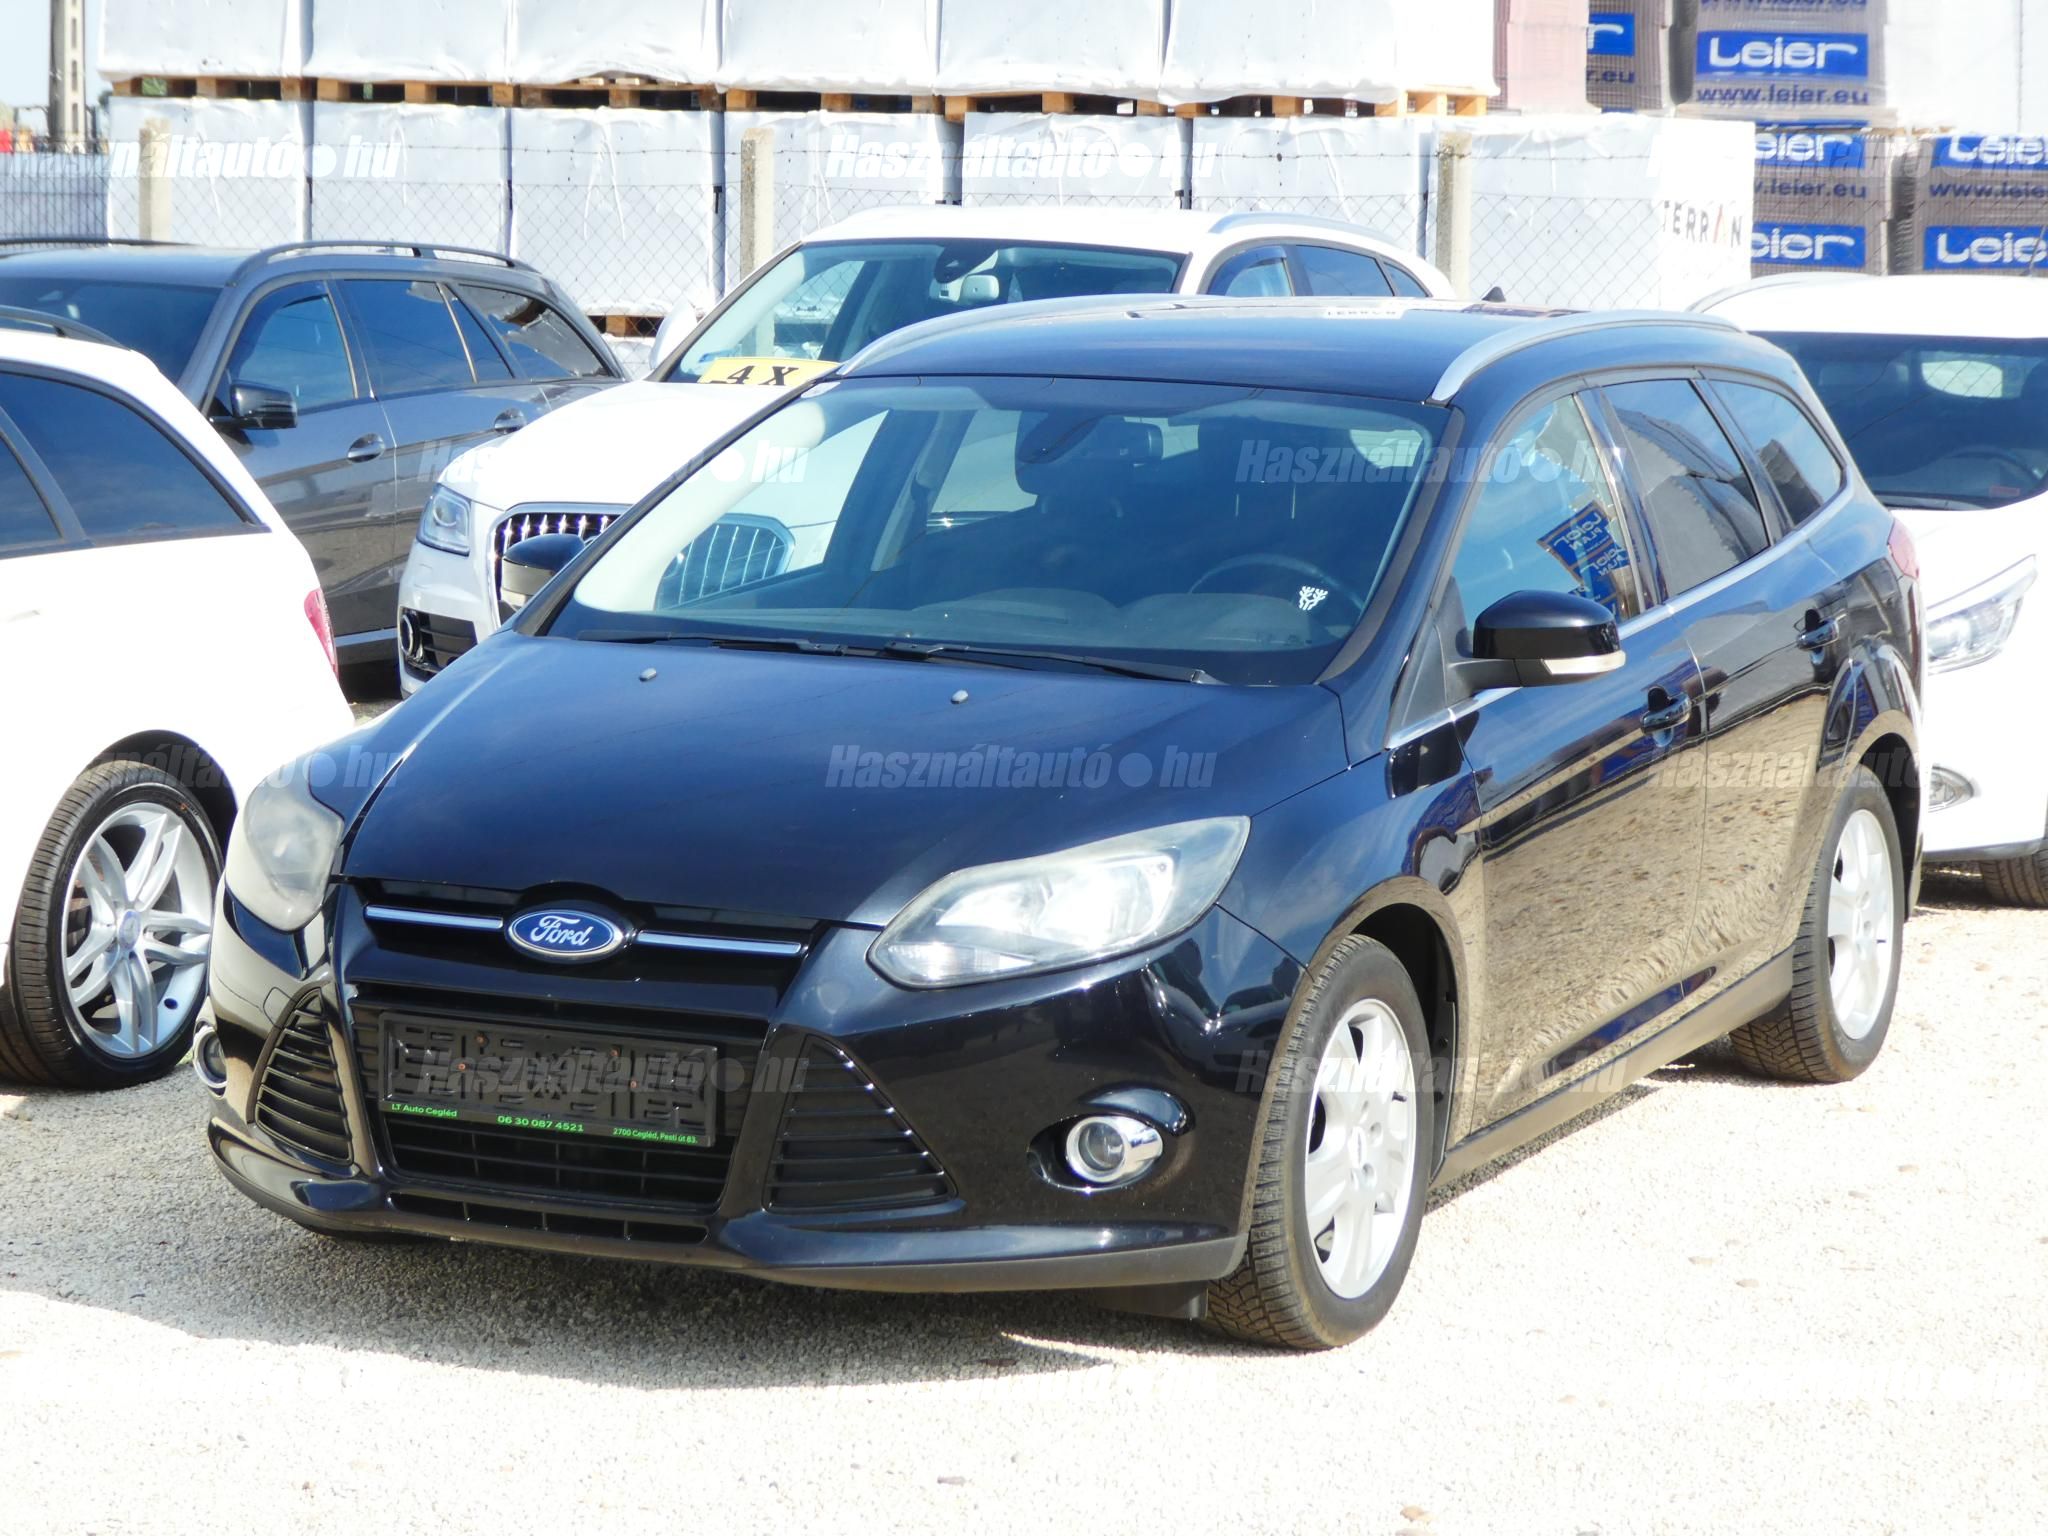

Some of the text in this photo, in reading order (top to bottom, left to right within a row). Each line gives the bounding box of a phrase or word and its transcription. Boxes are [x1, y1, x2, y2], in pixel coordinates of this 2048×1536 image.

[1709, 36, 1858, 69] Leier
[1697, 85, 1869, 105] www.leier.eu
[1755, 133, 1852, 161] eier
[1949, 134, 2048, 165] Leie
[1751, 228, 1855, 260] eier
[1937, 232, 2048, 264] Leie
[530, 915, 594, 946] Ford
[391, 1103, 458, 1117] LT Auto Cegléd
[497, 1115, 513, 1124] 06
[514, 1117, 530, 1126] 30
[555, 1121, 584, 1133] 4521
[613, 1128, 631, 1136] 2700
